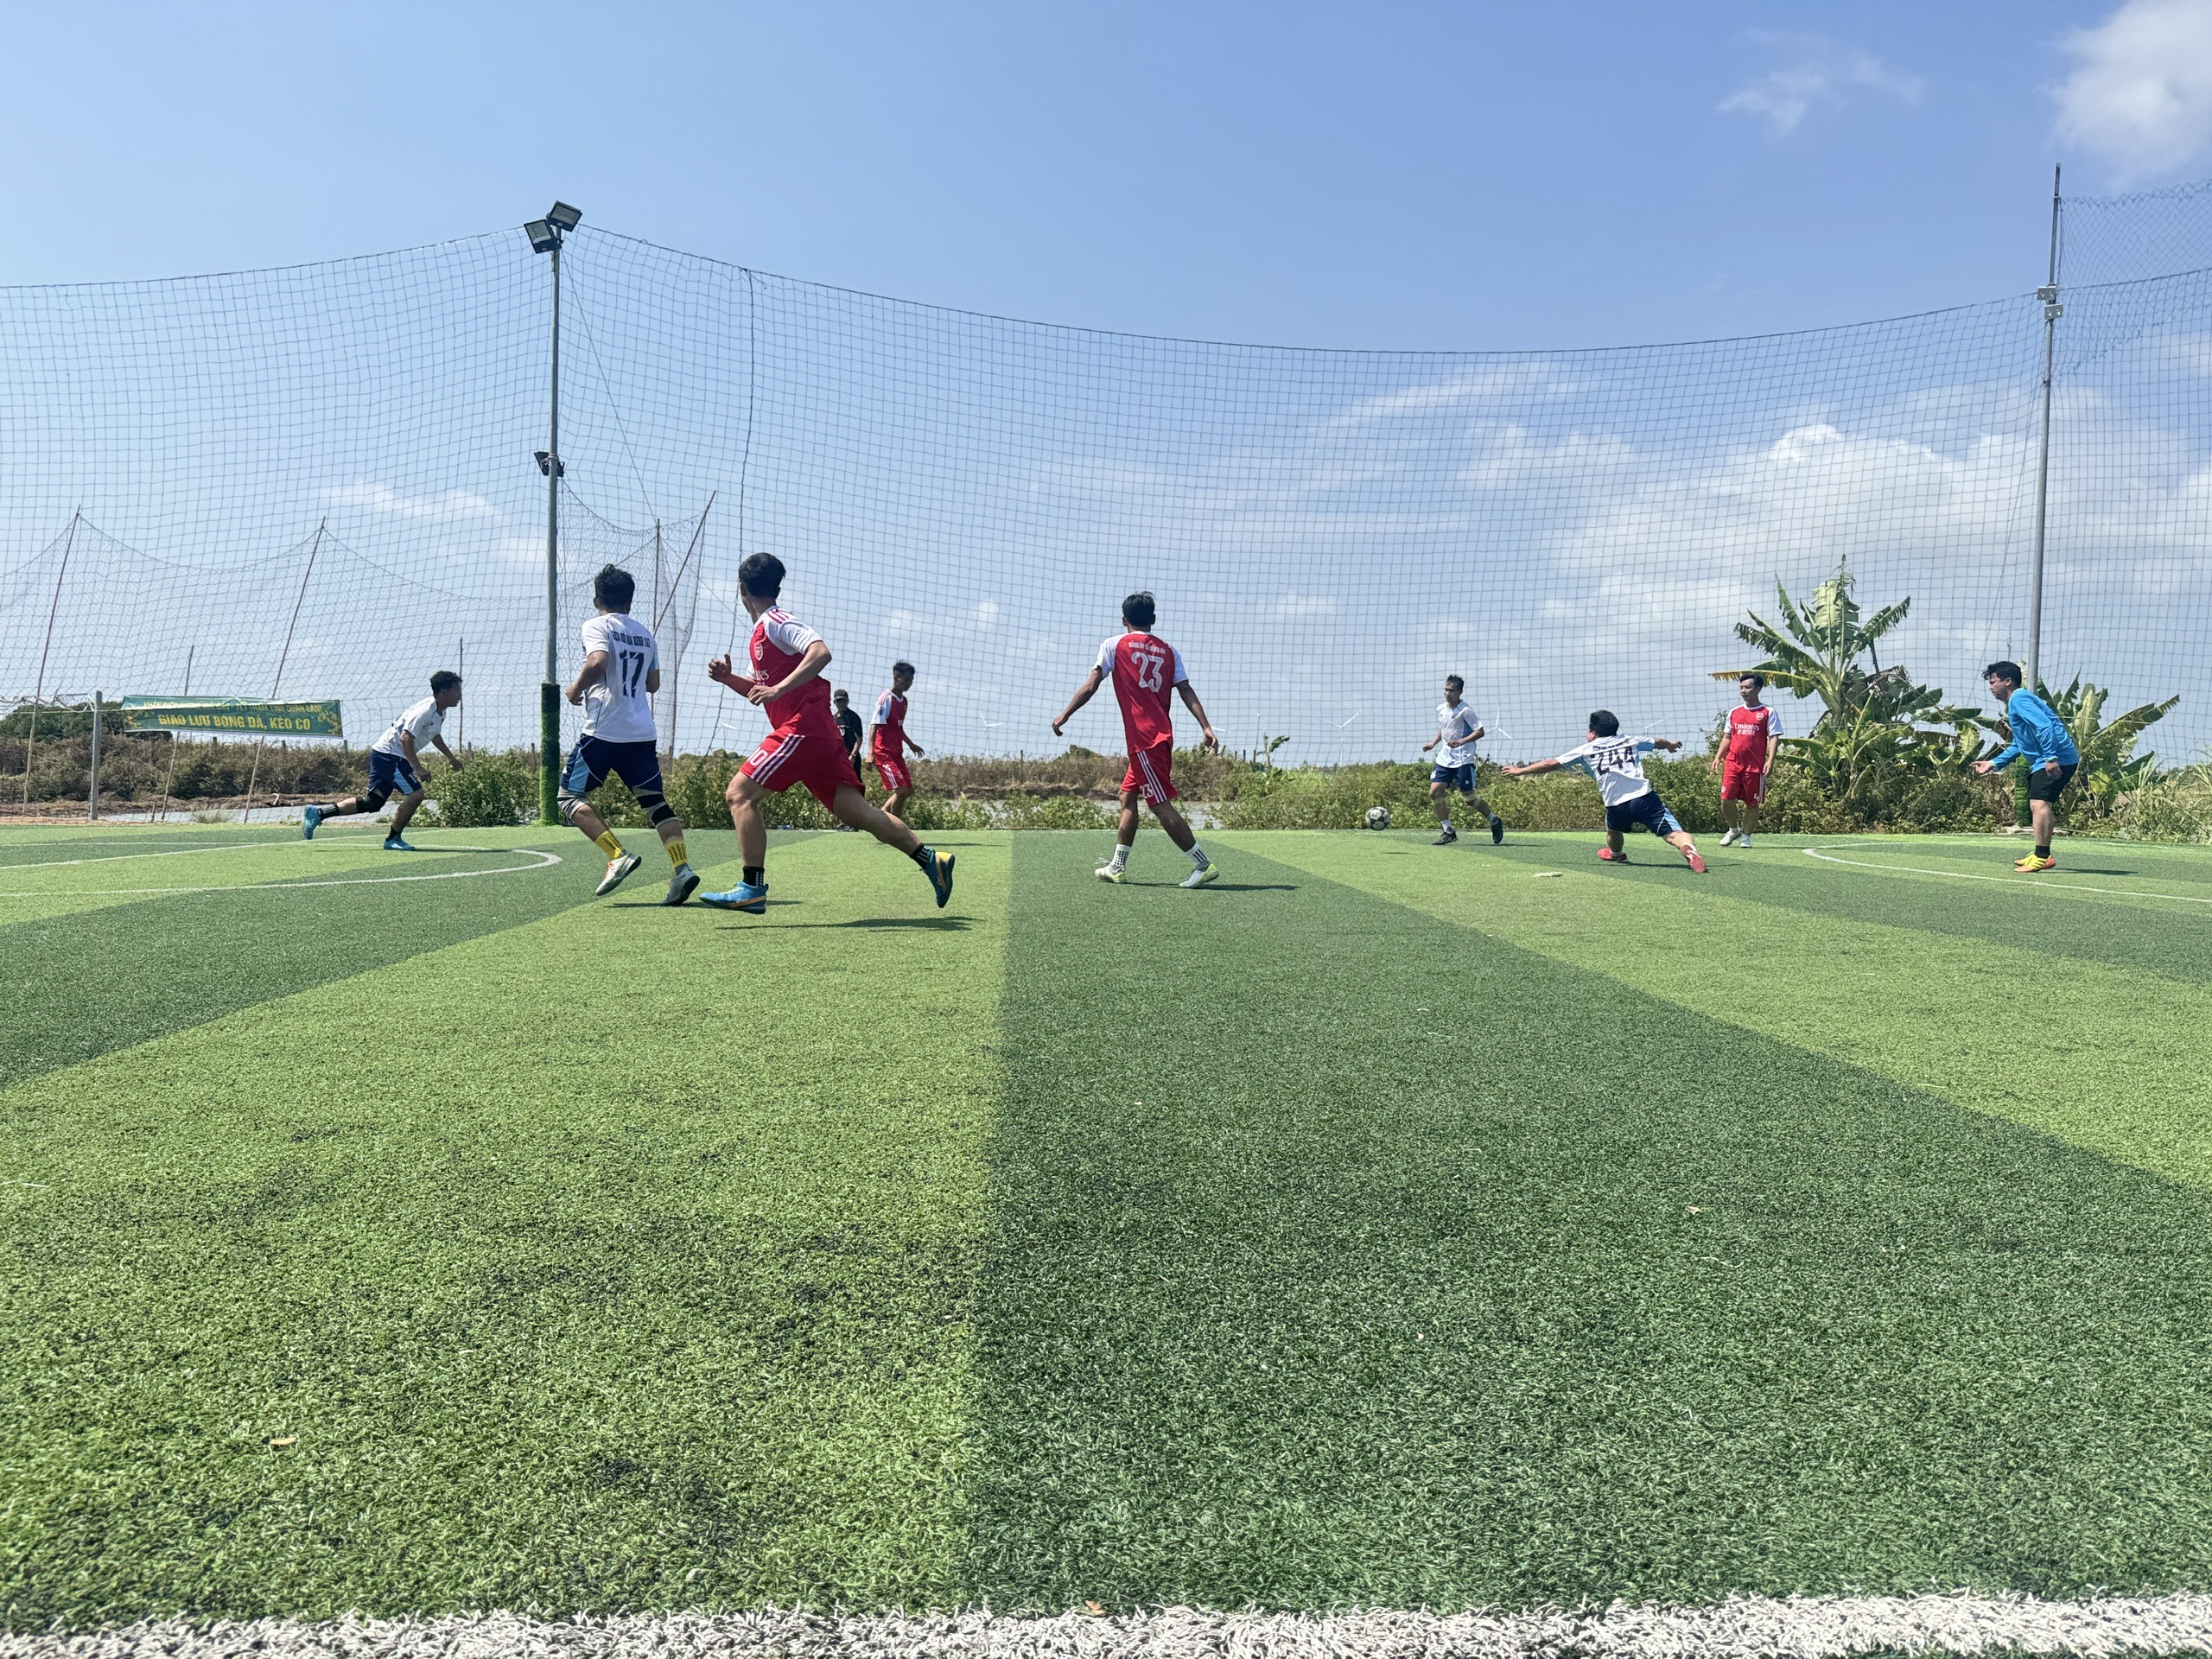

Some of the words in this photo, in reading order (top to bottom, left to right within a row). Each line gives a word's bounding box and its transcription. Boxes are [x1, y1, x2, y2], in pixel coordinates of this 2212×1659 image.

[620, 650, 645, 698] 17
[1131, 652, 1164, 693] 23
[157, 714, 187, 726] GIAO
[295, 718, 311, 731] CO
[1140, 784, 1154, 799] 23
